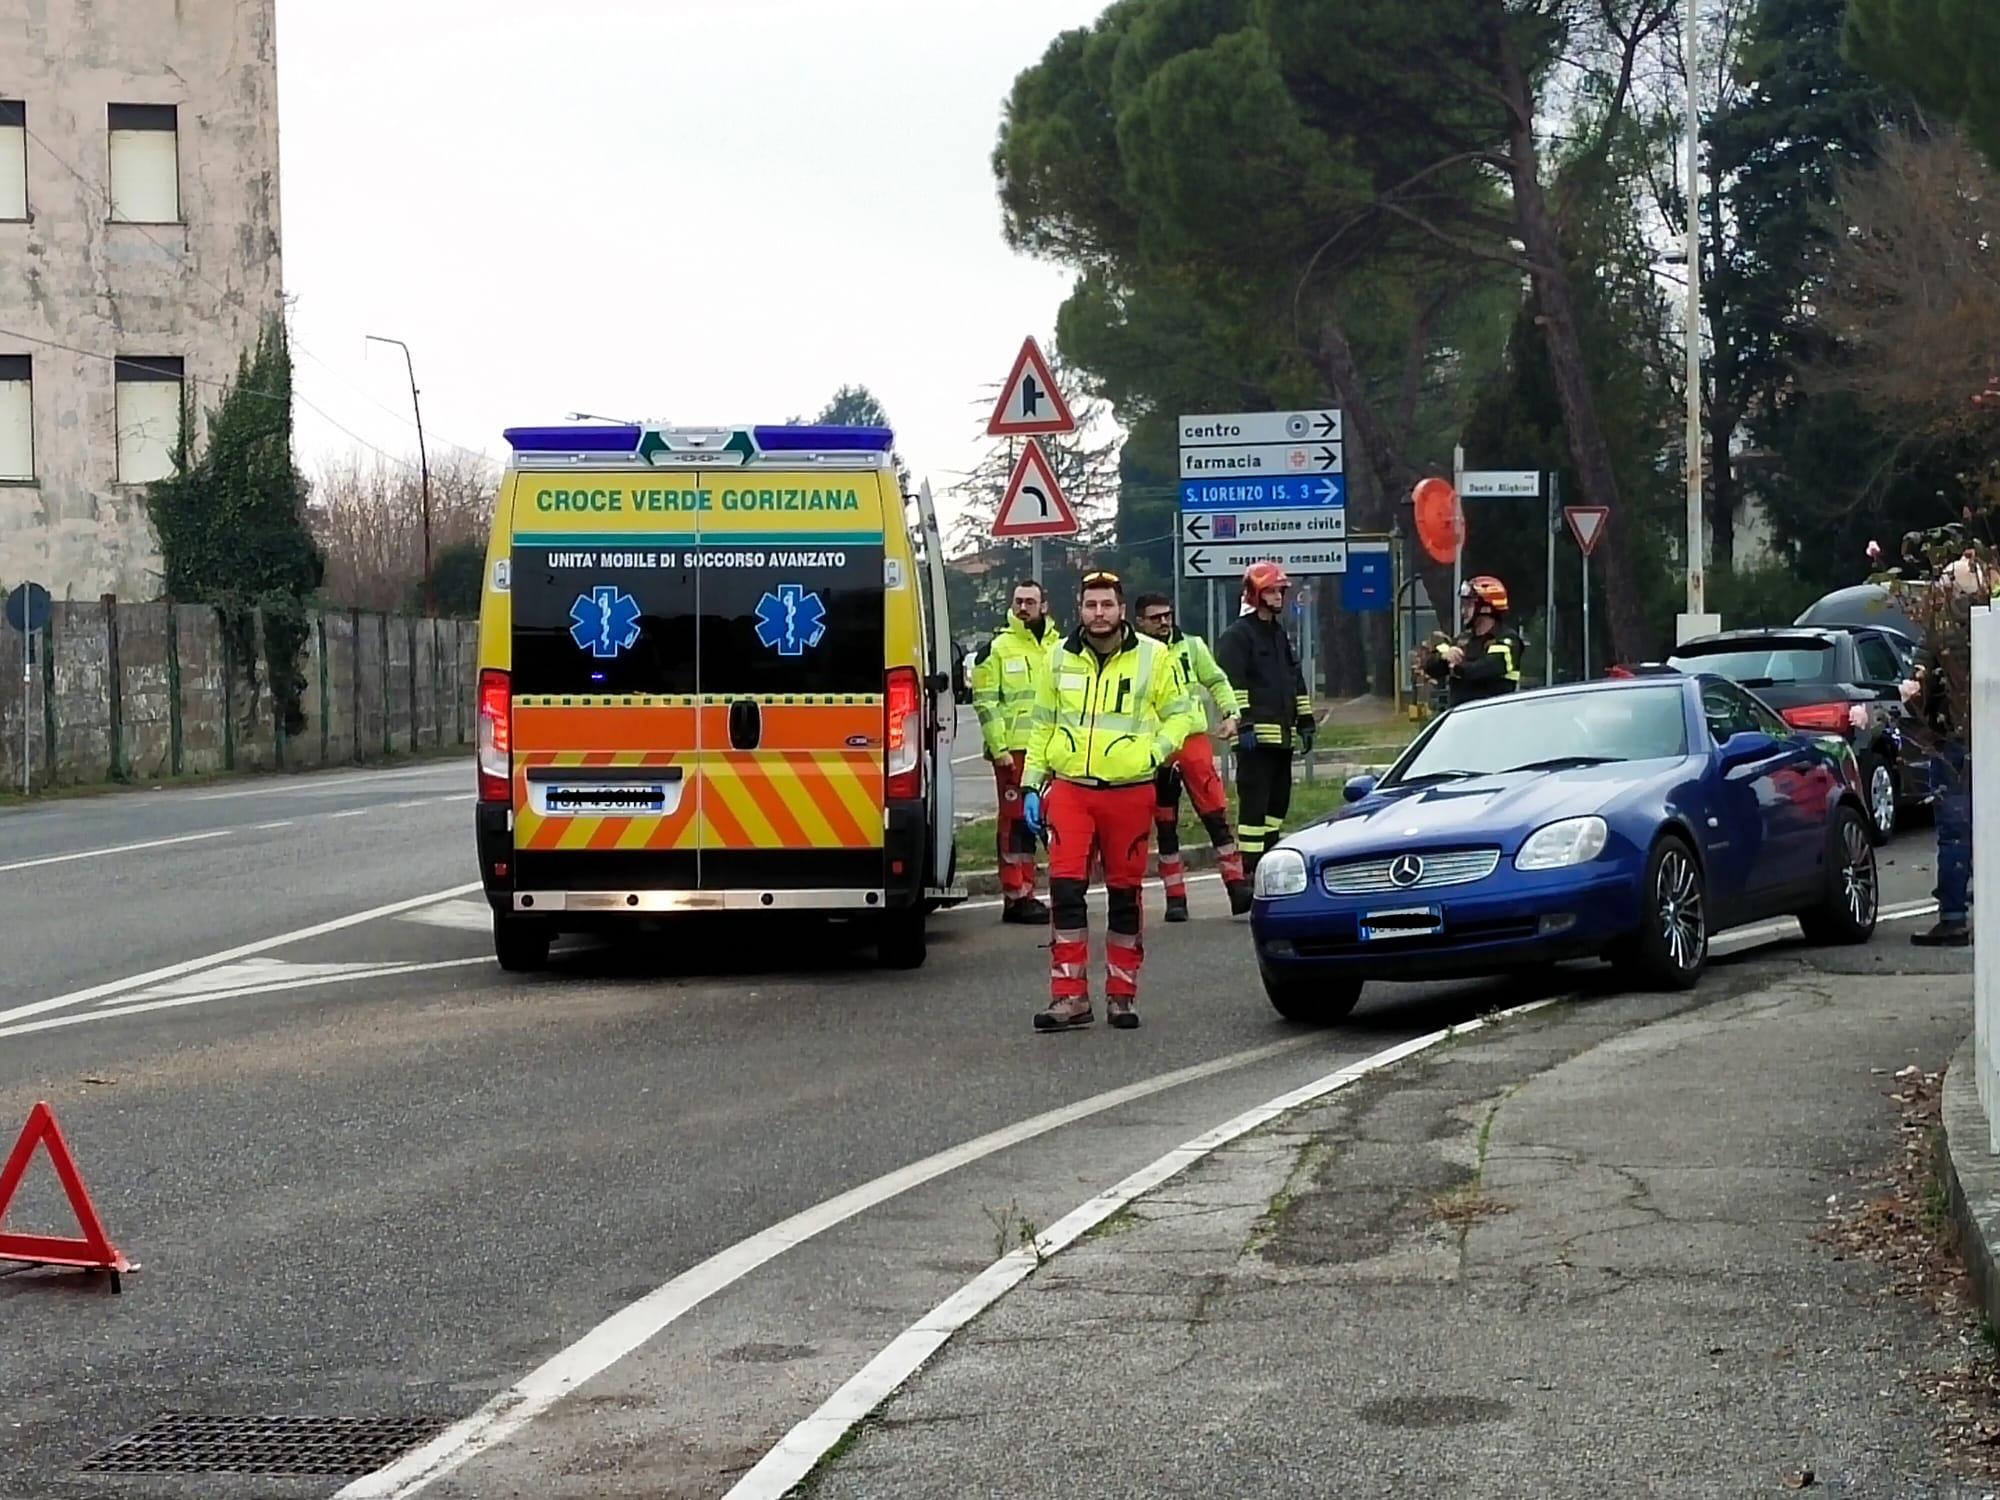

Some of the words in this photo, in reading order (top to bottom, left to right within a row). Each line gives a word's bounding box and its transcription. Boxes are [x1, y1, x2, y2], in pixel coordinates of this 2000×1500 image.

[1184, 423, 1241, 438] centro
[1186, 454, 1262, 470] farmacia
[536, 489, 622, 512] CROCE
[631, 489, 713, 512] VERDE
[721, 489, 859, 511] GORIZIANA
[1186, 488, 1199, 502] S.
[1202, 485, 1264, 502] LORENZO
[1272, 485, 1291, 500] IS.
[1300, 484, 1310, 499] 3
[1239, 517, 1302, 534] protezione
[1307, 516, 1342, 530] civile
[549, 552, 597, 568] UNITA'
[600, 552, 657, 568] MOBILE
[660, 553, 676, 568] DI
[683, 552, 765, 568] SOCCORSO
[769, 552, 846, 568] AVANZATO
[1289, 551, 1342, 564] comunale
